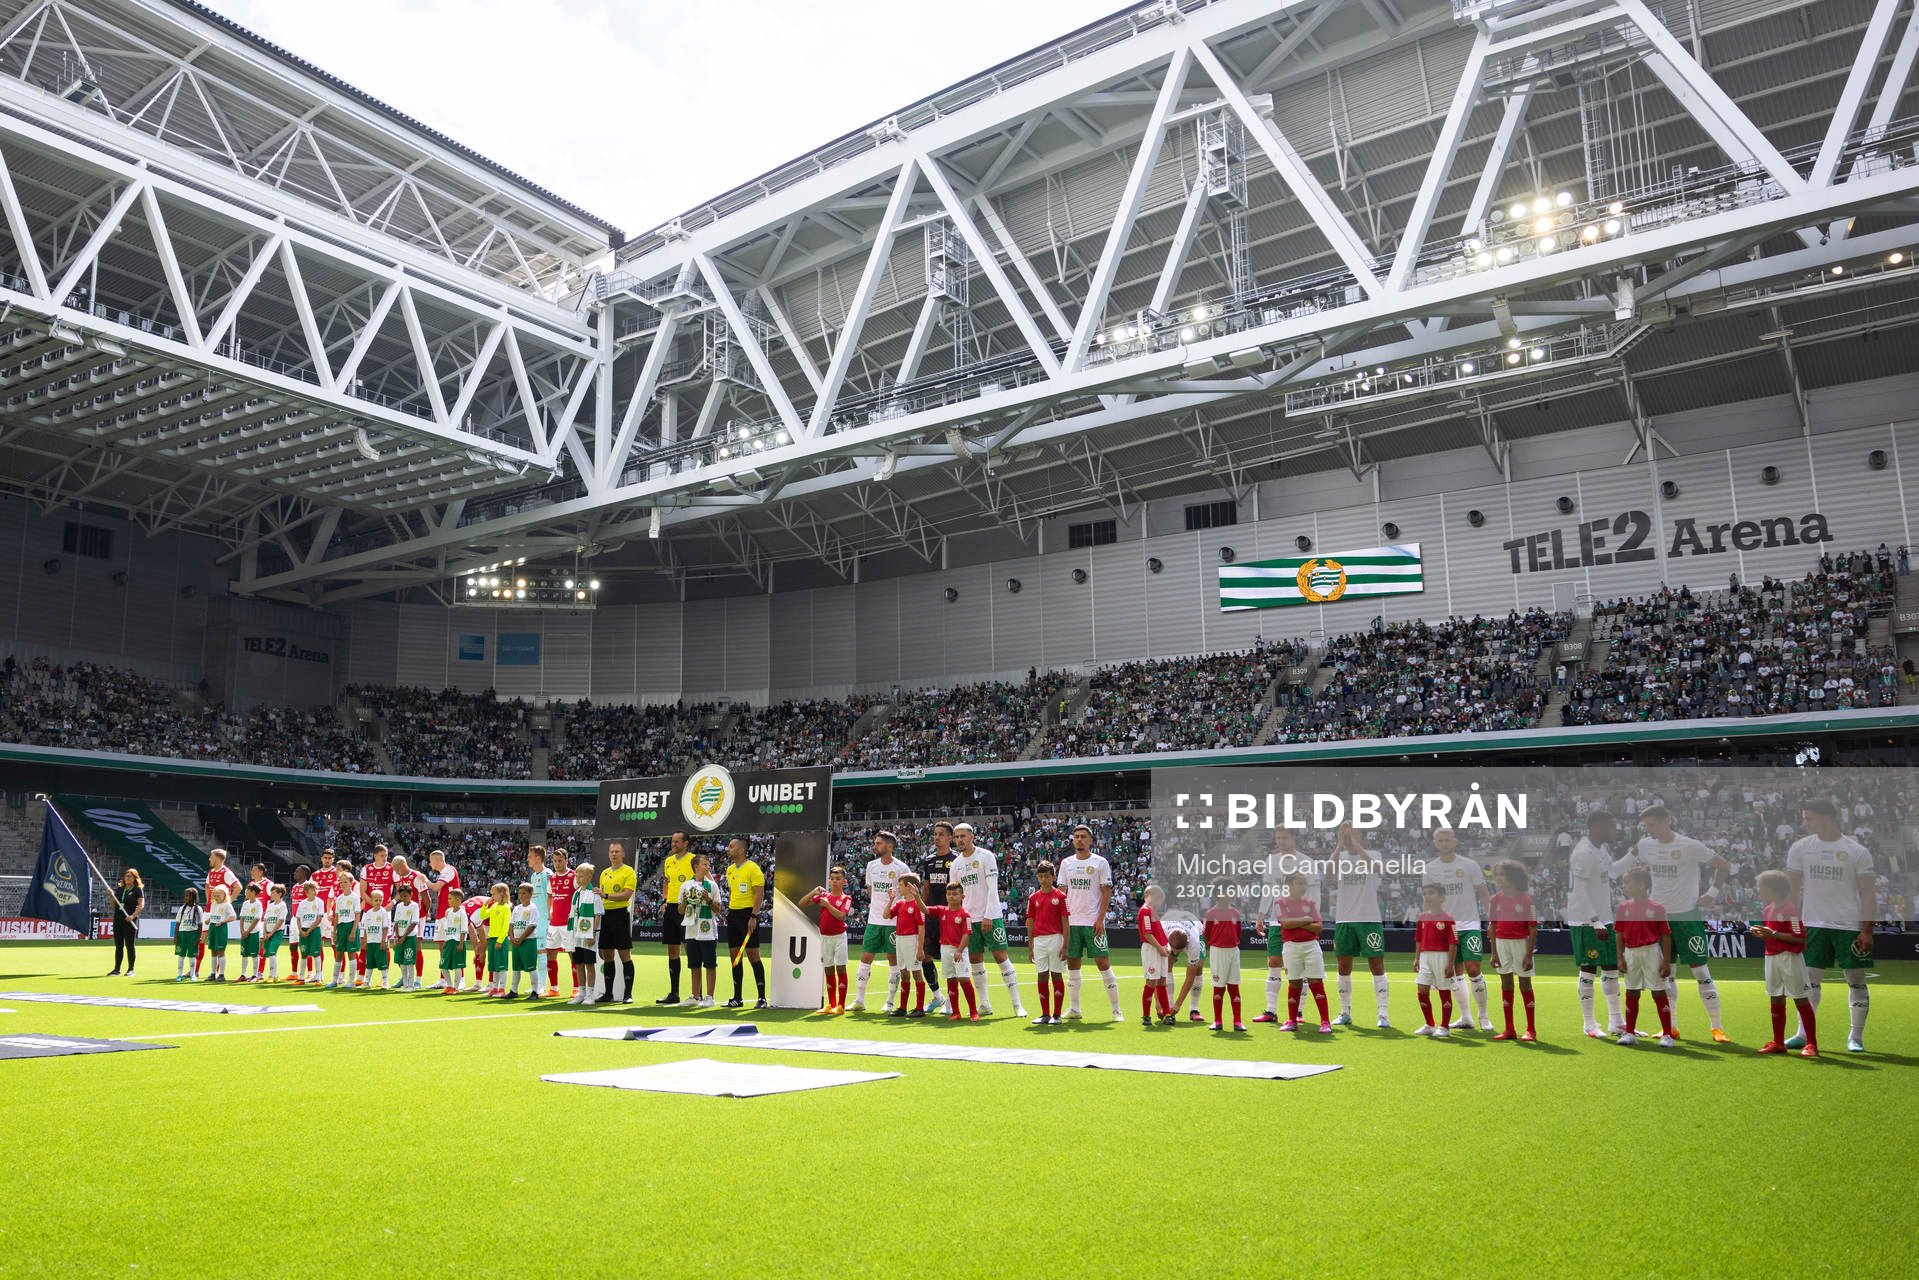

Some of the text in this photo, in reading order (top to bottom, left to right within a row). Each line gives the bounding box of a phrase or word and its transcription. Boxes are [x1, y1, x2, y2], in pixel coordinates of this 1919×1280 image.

[1503, 510, 1834, 574] TELE2 Arena
[244, 637, 329, 664] TELE2 Arena
[1564, 641, 1583, 651] B308
[748, 782, 817, 803] UNIBET
[610, 791, 670, 811] UNIBET
[1527, 836, 1550, 845] A108
[1809, 864, 1844, 876] HUSKI
[1070, 878, 1091, 887] HUSKI
[1343, 873, 1366, 882] HUSKI
[1442, 883, 1464, 891] USKI
[1008, 934, 1023, 942] Stolt
[1250, 937, 1268, 945] Stolt
[789, 936, 807, 965] U
